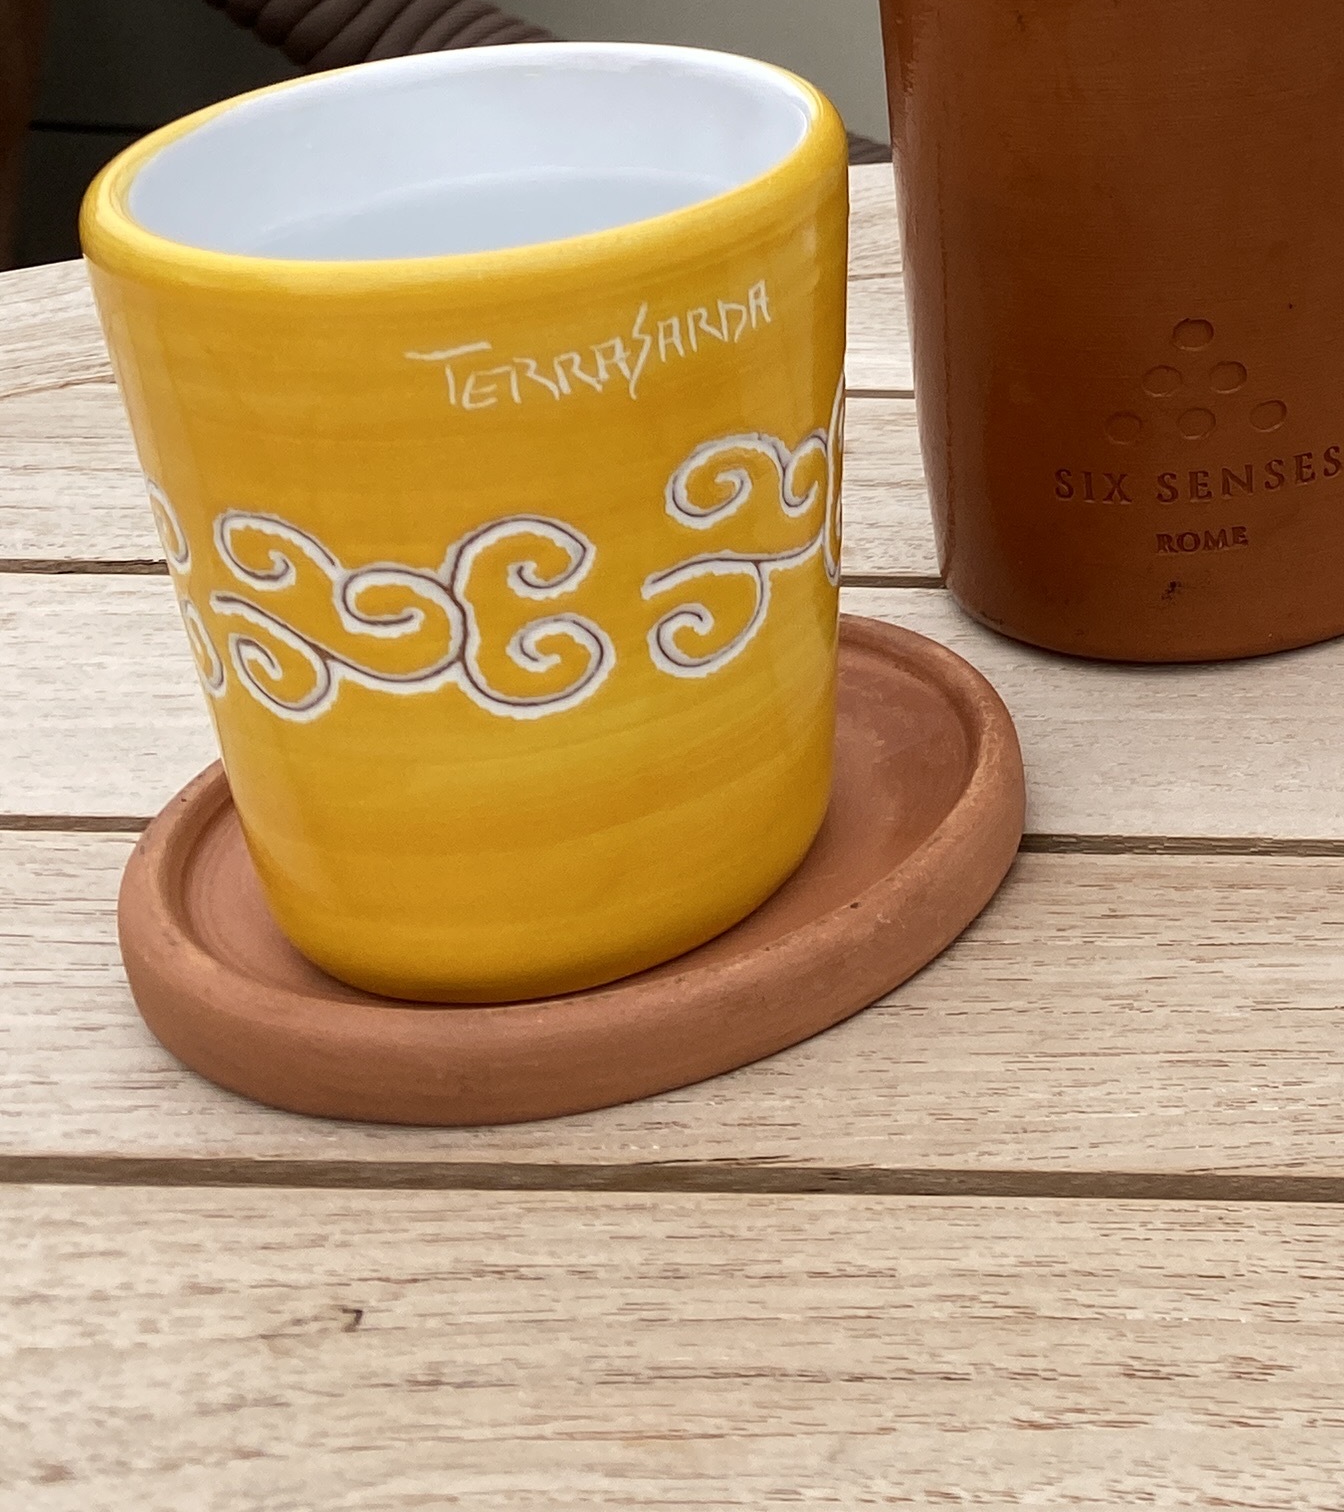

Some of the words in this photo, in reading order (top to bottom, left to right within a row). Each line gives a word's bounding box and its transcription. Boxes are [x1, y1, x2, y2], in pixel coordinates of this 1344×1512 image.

[1053, 468, 1134, 504] SIX
[1156, 445, 1344, 505] SENSES
[1155, 525, 1249, 555] ROME
